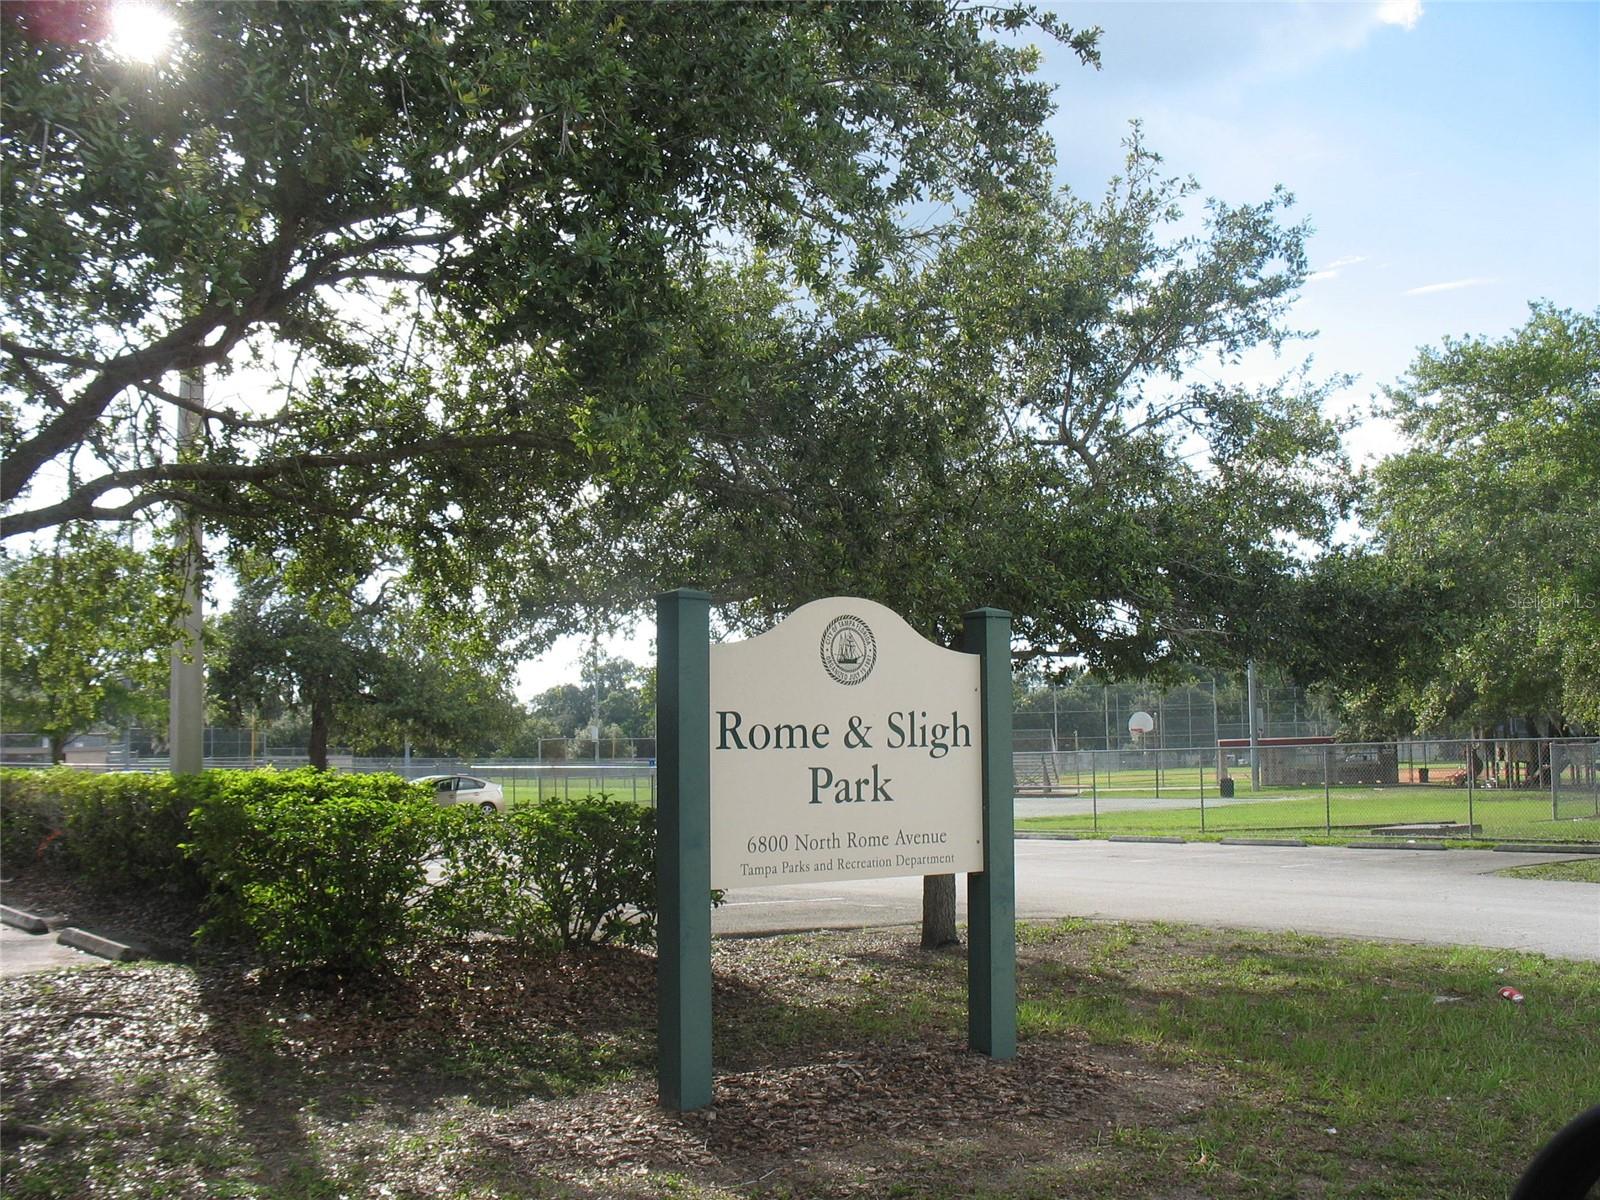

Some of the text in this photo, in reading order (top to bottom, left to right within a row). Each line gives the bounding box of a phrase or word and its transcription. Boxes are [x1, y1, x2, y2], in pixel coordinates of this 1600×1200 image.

[838, 620, 856, 628] TAMPA
[855, 623, 871, 645] FLORIDA
[715, 711, 972, 759] Rome & Sligh
[807, 764, 894, 804] Park
[747, 829, 947, 854] 6800 North Rome Avenue
[740, 853, 955, 879] Tampa Parks and Recreation Department
